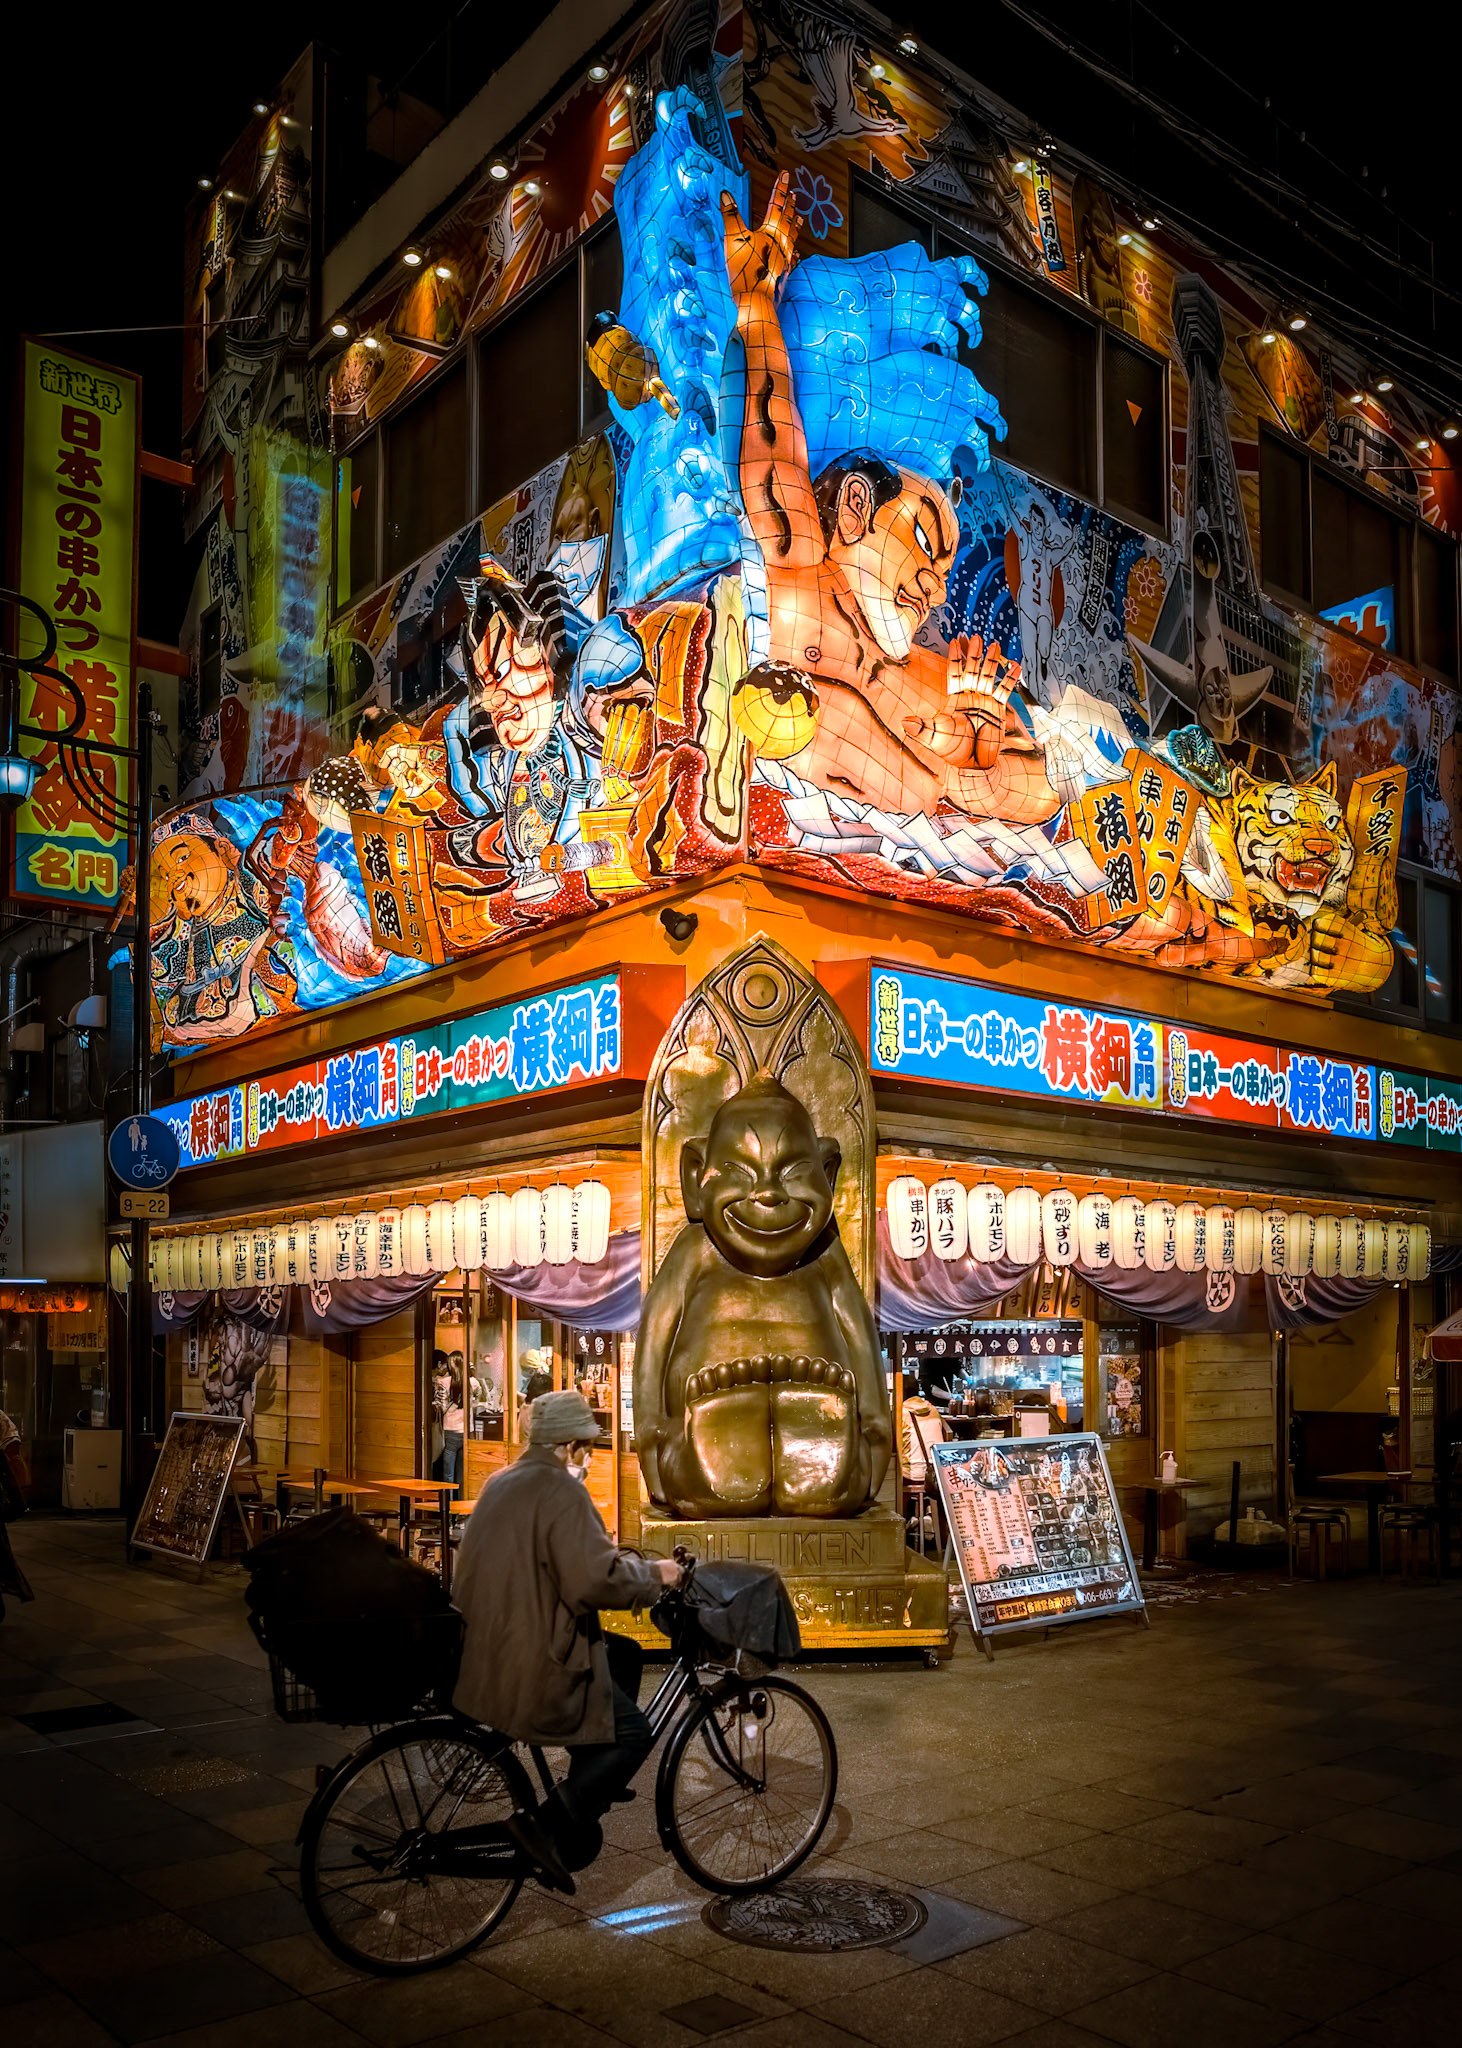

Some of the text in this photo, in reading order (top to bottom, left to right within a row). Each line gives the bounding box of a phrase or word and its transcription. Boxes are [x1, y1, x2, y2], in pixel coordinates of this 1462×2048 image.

[40, 358, 121, 412] 新世界
[56, 405, 103, 651] 日本一の串かつ
[30, 658, 121, 844] 横綱
[1093, 792, 1139, 914] 横綱
[1149, 785, 1188, 902] 日本一の
[31, 845, 116, 896] 名門
[362, 831, 404, 942] 横綱
[394, 832, 423, 957] 日本一の串かつ
[401, 985, 621, 1115] 新世界 日本一の串かつ 横綱 名門
[878, 978, 1156, 1099] 新世界 日本一の串かつ 横綱 名門
[248, 1042, 399, 1146] 新世界 日本一の串かつ 横綱 名門
[1170, 1032, 1372, 1131] 新世界 日本一の串かつ 横綱 名門
[1381, 1074, 1393, 1135] 新世界
[190, 1094, 231, 1160] 横綱
[231, 1088, 244, 1152] 名門
[934, 1187, 956, 1196] 串かつ
[985, 1191, 1004, 1200] 串かつ
[1051, 1198, 1072, 1206] 串かつ
[910, 1200, 926, 1248] 串かつ
[937, 1198, 954, 1249] 豚バラ
[988, 1202, 1004, 1252] ホルモン
[1055, 1207, 1071, 1256] 砂ずり
[1095, 1212, 1111, 1259] 海老
[1134, 1214, 1145, 1258] ほたて
[1164, 1216, 1176, 1262] サーモン
[1271, 1224, 1285, 1268] にんにく
[235, 1243, 247, 1281] ホルモン
[336, 1230, 350, 1273] サーモン
[674, 1532, 871, 1566] BILLIKEN
